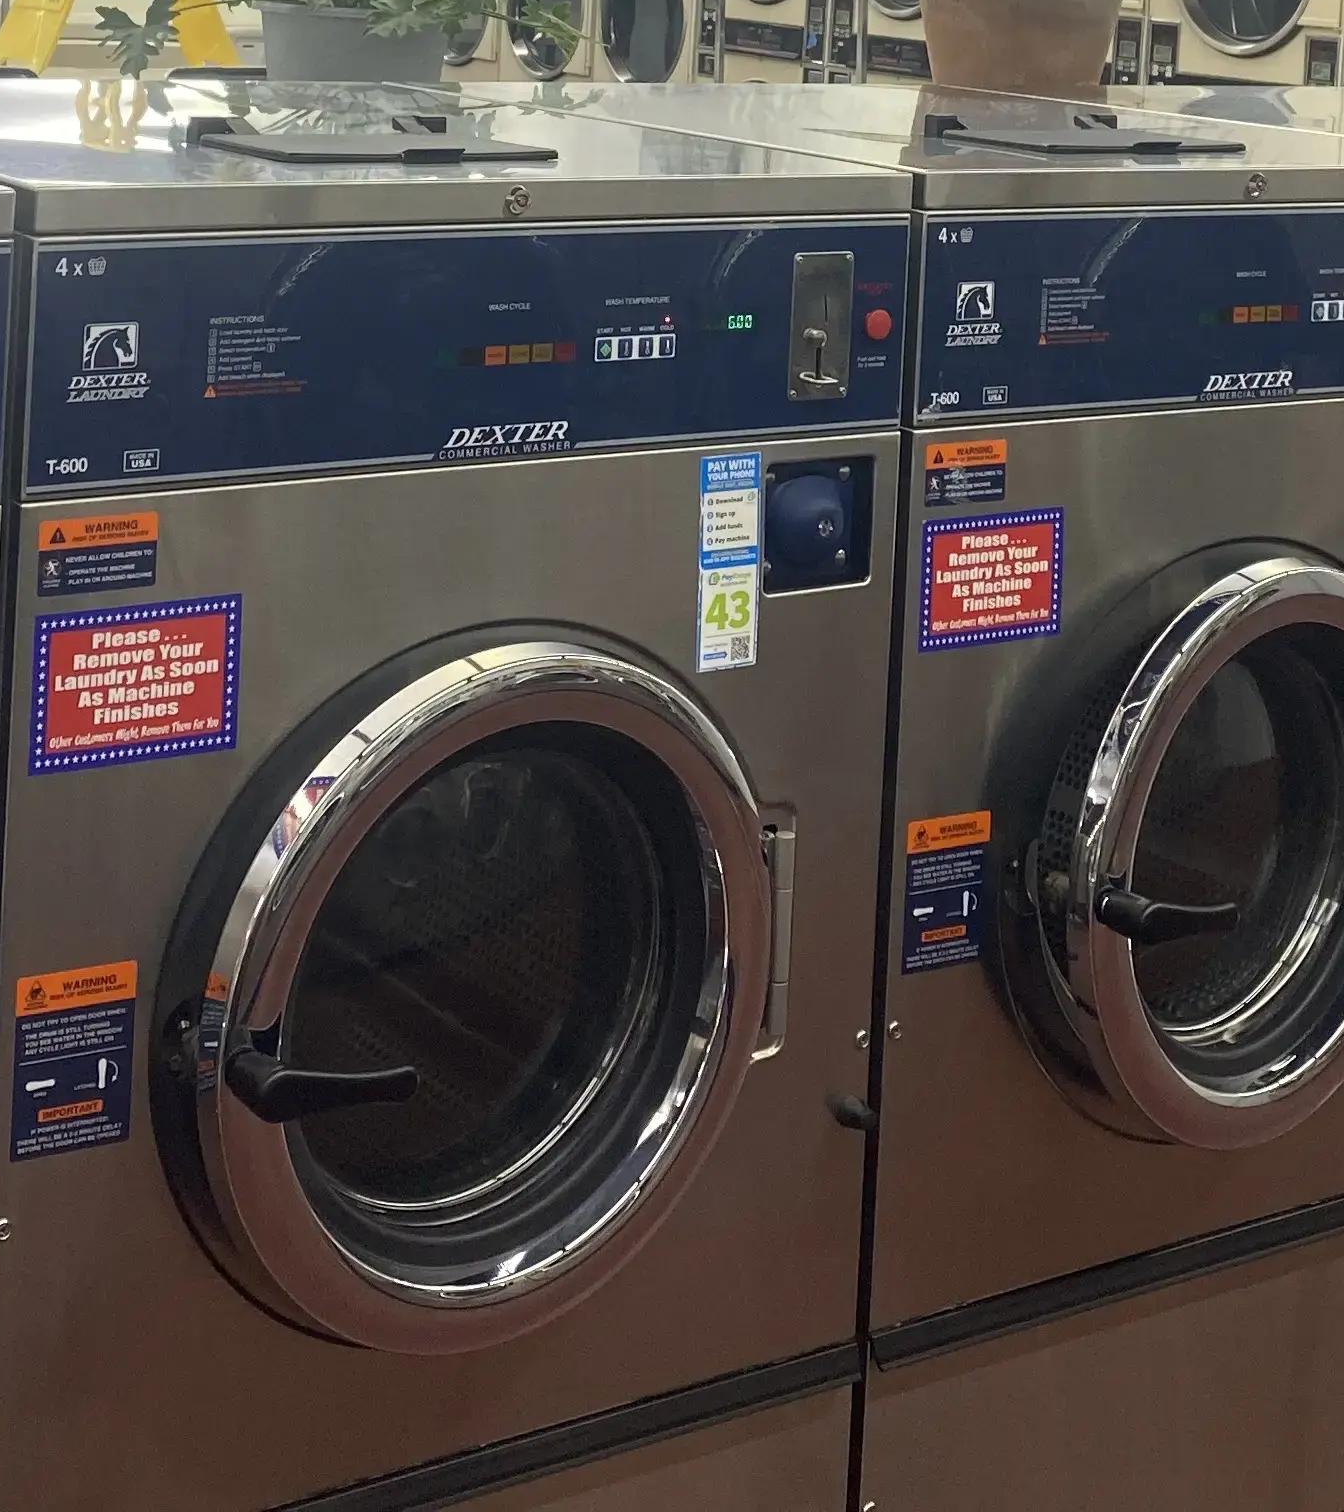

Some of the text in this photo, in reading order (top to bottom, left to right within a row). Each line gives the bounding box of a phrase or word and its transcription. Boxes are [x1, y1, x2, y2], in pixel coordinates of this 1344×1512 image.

[938, 227, 947, 243] 4
[55, 257, 69, 277] 4
[946, 323, 1000, 336] DEXTER
[68, 373, 147, 389] DEXTER
[1203, 371, 1293, 393] DEXTER
[66, 387, 150, 403] LAUNDRY
[1200, 388, 1294, 402] COMMERCIAL WASHER
[444, 420, 570, 448] DEXTER
[438, 440, 572, 461] COMMERCIAL WASHER
[46, 458, 152, 476] T-600 USA
[707, 458, 756, 473] PAY WITH
[85, 519, 139, 534] WARNING
[949, 545, 1038, 567] Remove Your
[936, 560, 1049, 584] Laundry As Soon
[952, 577, 1032, 598] As Machine
[705, 590, 751, 631] 43
[962, 593, 1021, 612] Finishes
[73, 642, 203, 671] Remove Your
[54, 658, 219, 692] Laundry As Soon
[78, 681, 195, 708] As Machine
[94, 700, 179, 725] Finishes
[62, 974, 117, 991] WARNING
[42, 1101, 99, 1119] IMPORTANT
